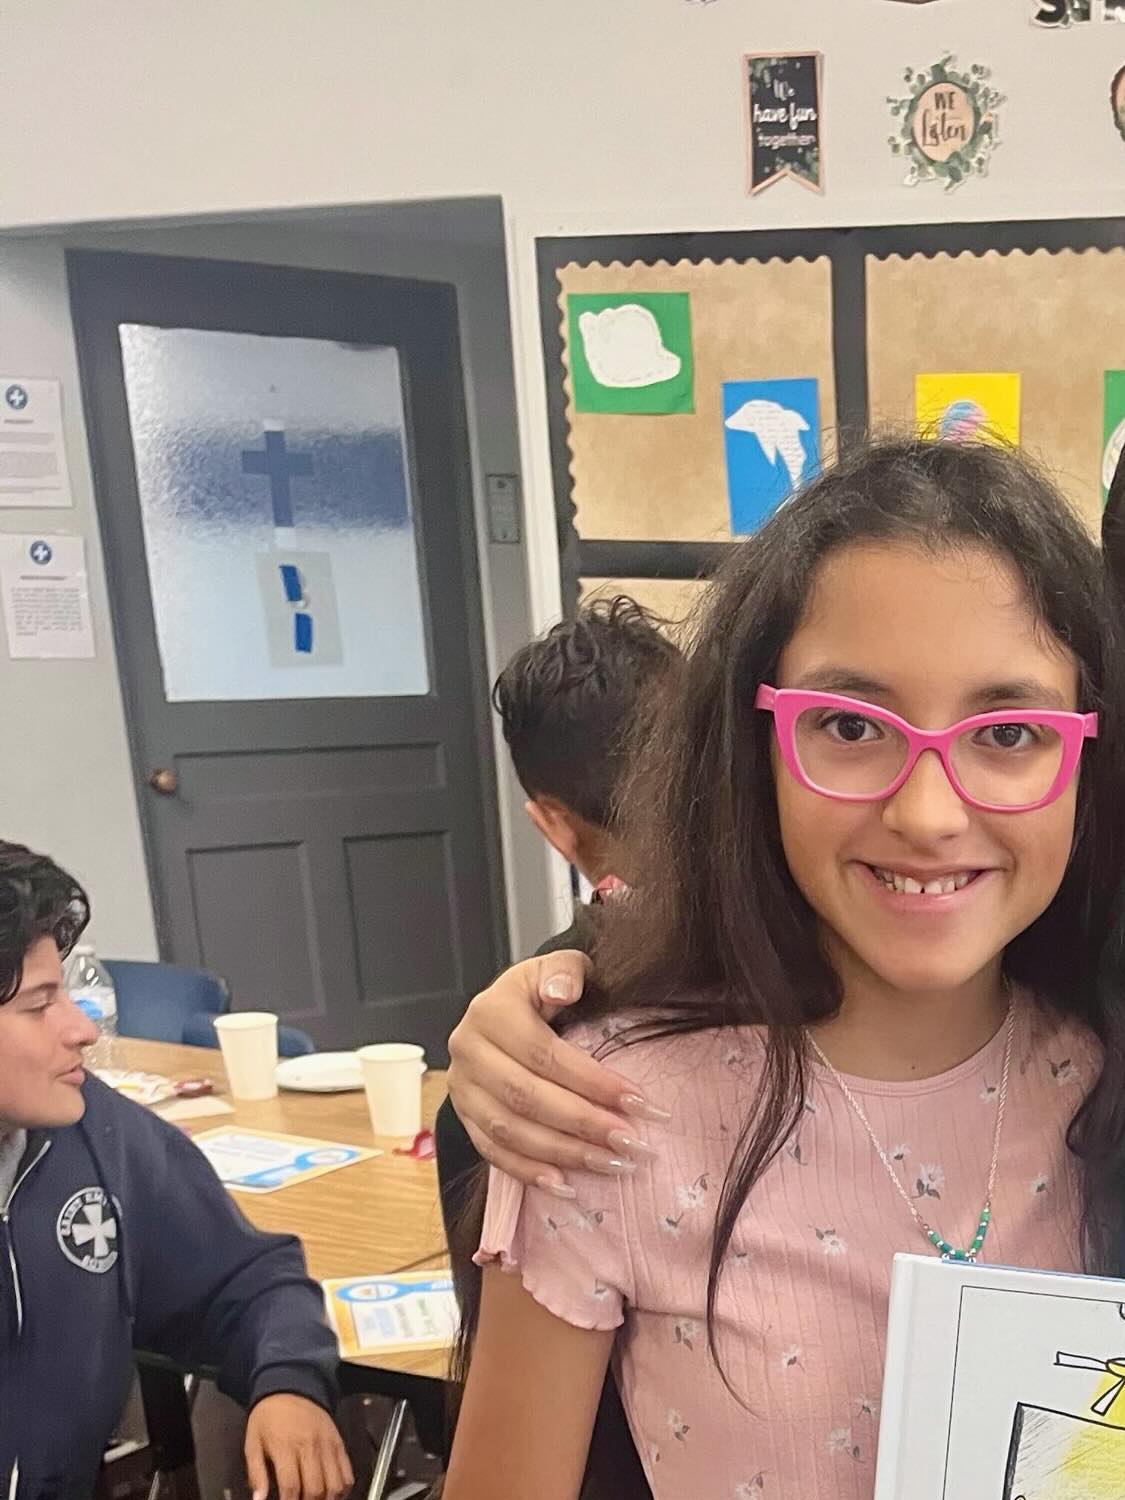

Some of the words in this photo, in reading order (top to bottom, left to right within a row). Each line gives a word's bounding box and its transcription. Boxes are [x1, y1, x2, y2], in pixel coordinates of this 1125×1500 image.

[934, 91, 956, 110] WE
[753, 103, 789, 123] have
[788, 102, 817, 130] fun
[922, 108, 967, 147] Listen
